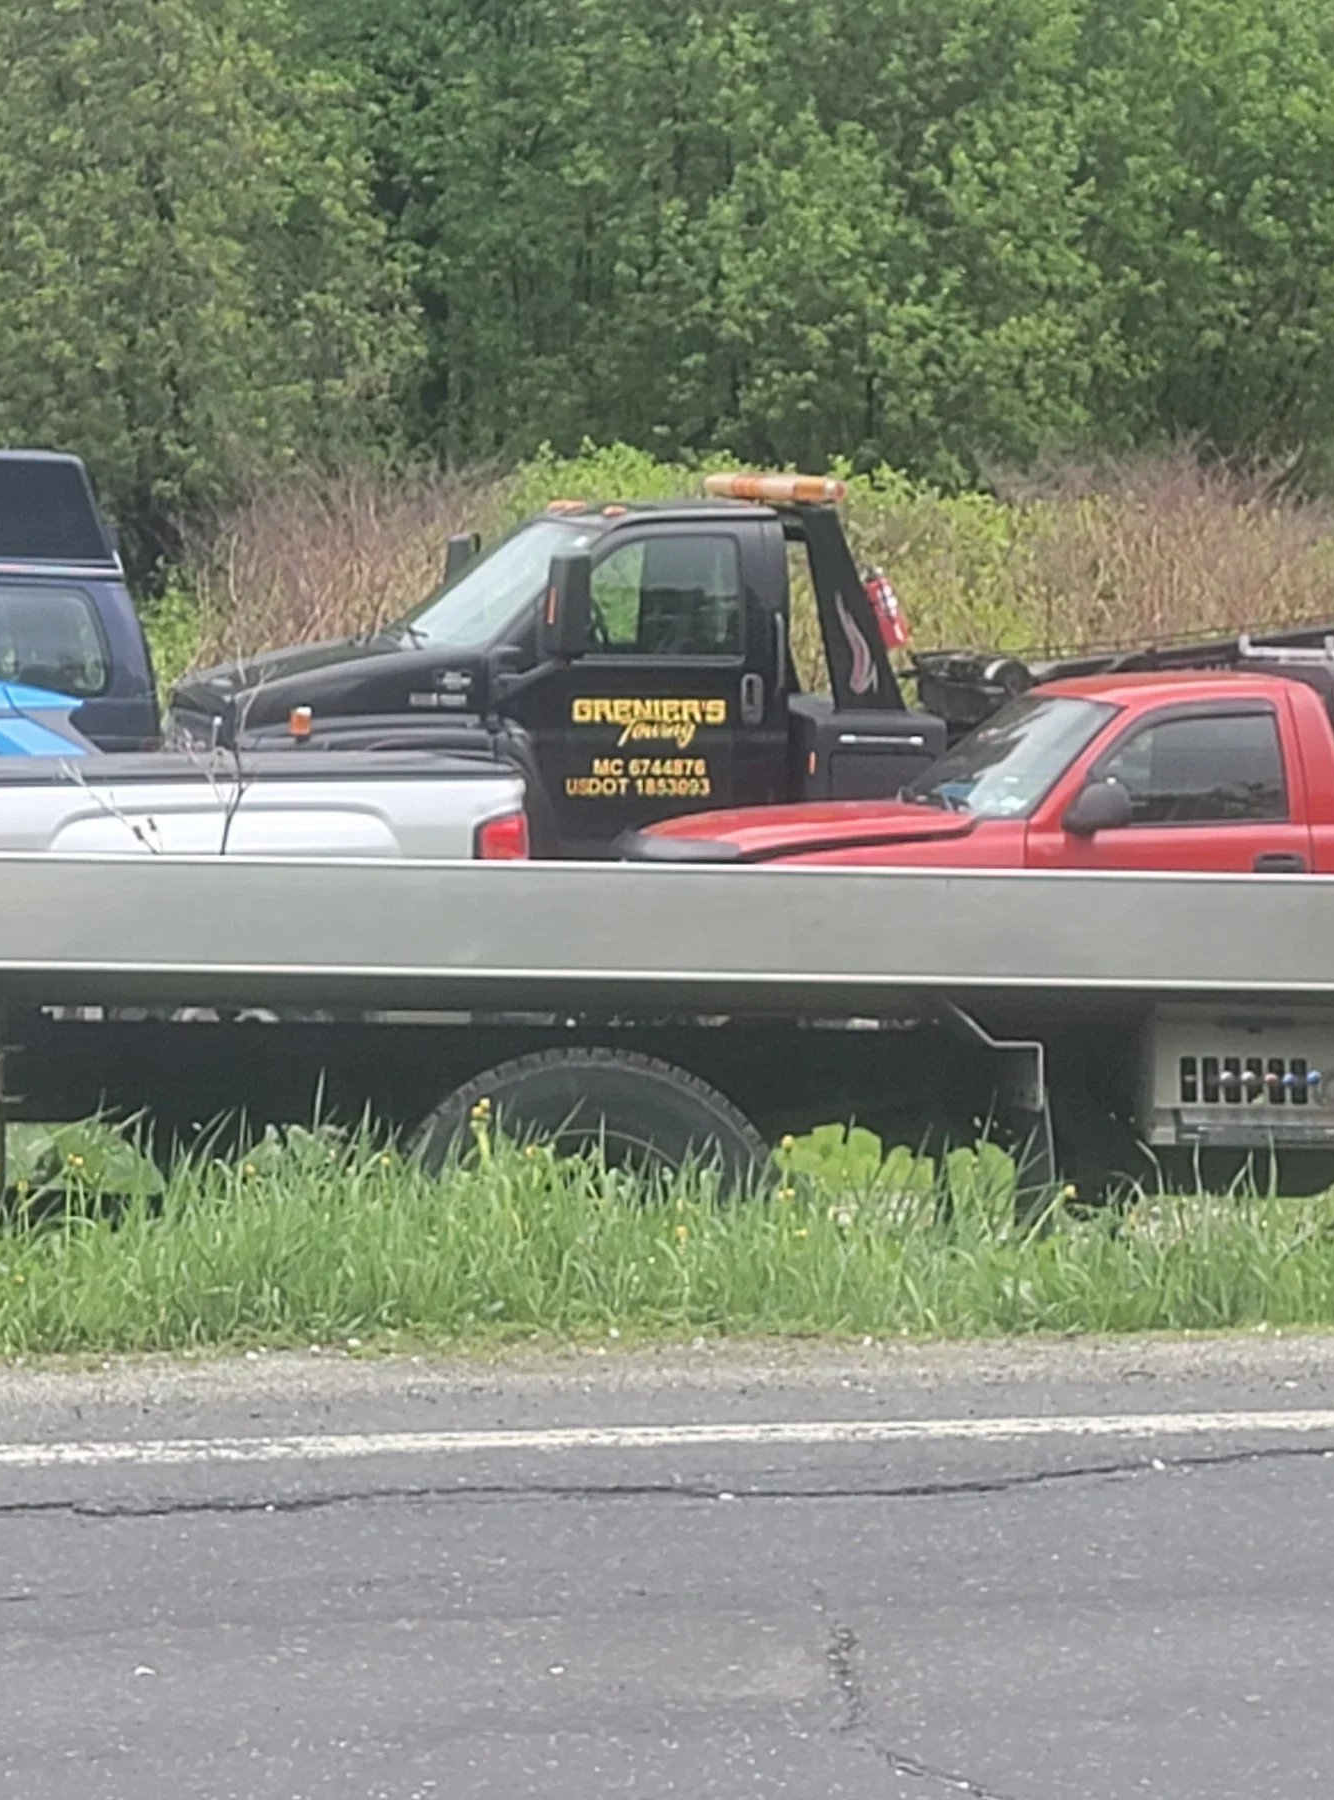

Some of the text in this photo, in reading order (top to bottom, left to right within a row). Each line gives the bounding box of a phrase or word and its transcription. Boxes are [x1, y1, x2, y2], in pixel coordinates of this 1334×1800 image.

[572, 698, 726, 724] GRENIER'S
[617, 718, 696, 749] Towing
[593, 758, 706, 776] MC 6744876
[566, 777, 710, 796] USDOT 1853093
